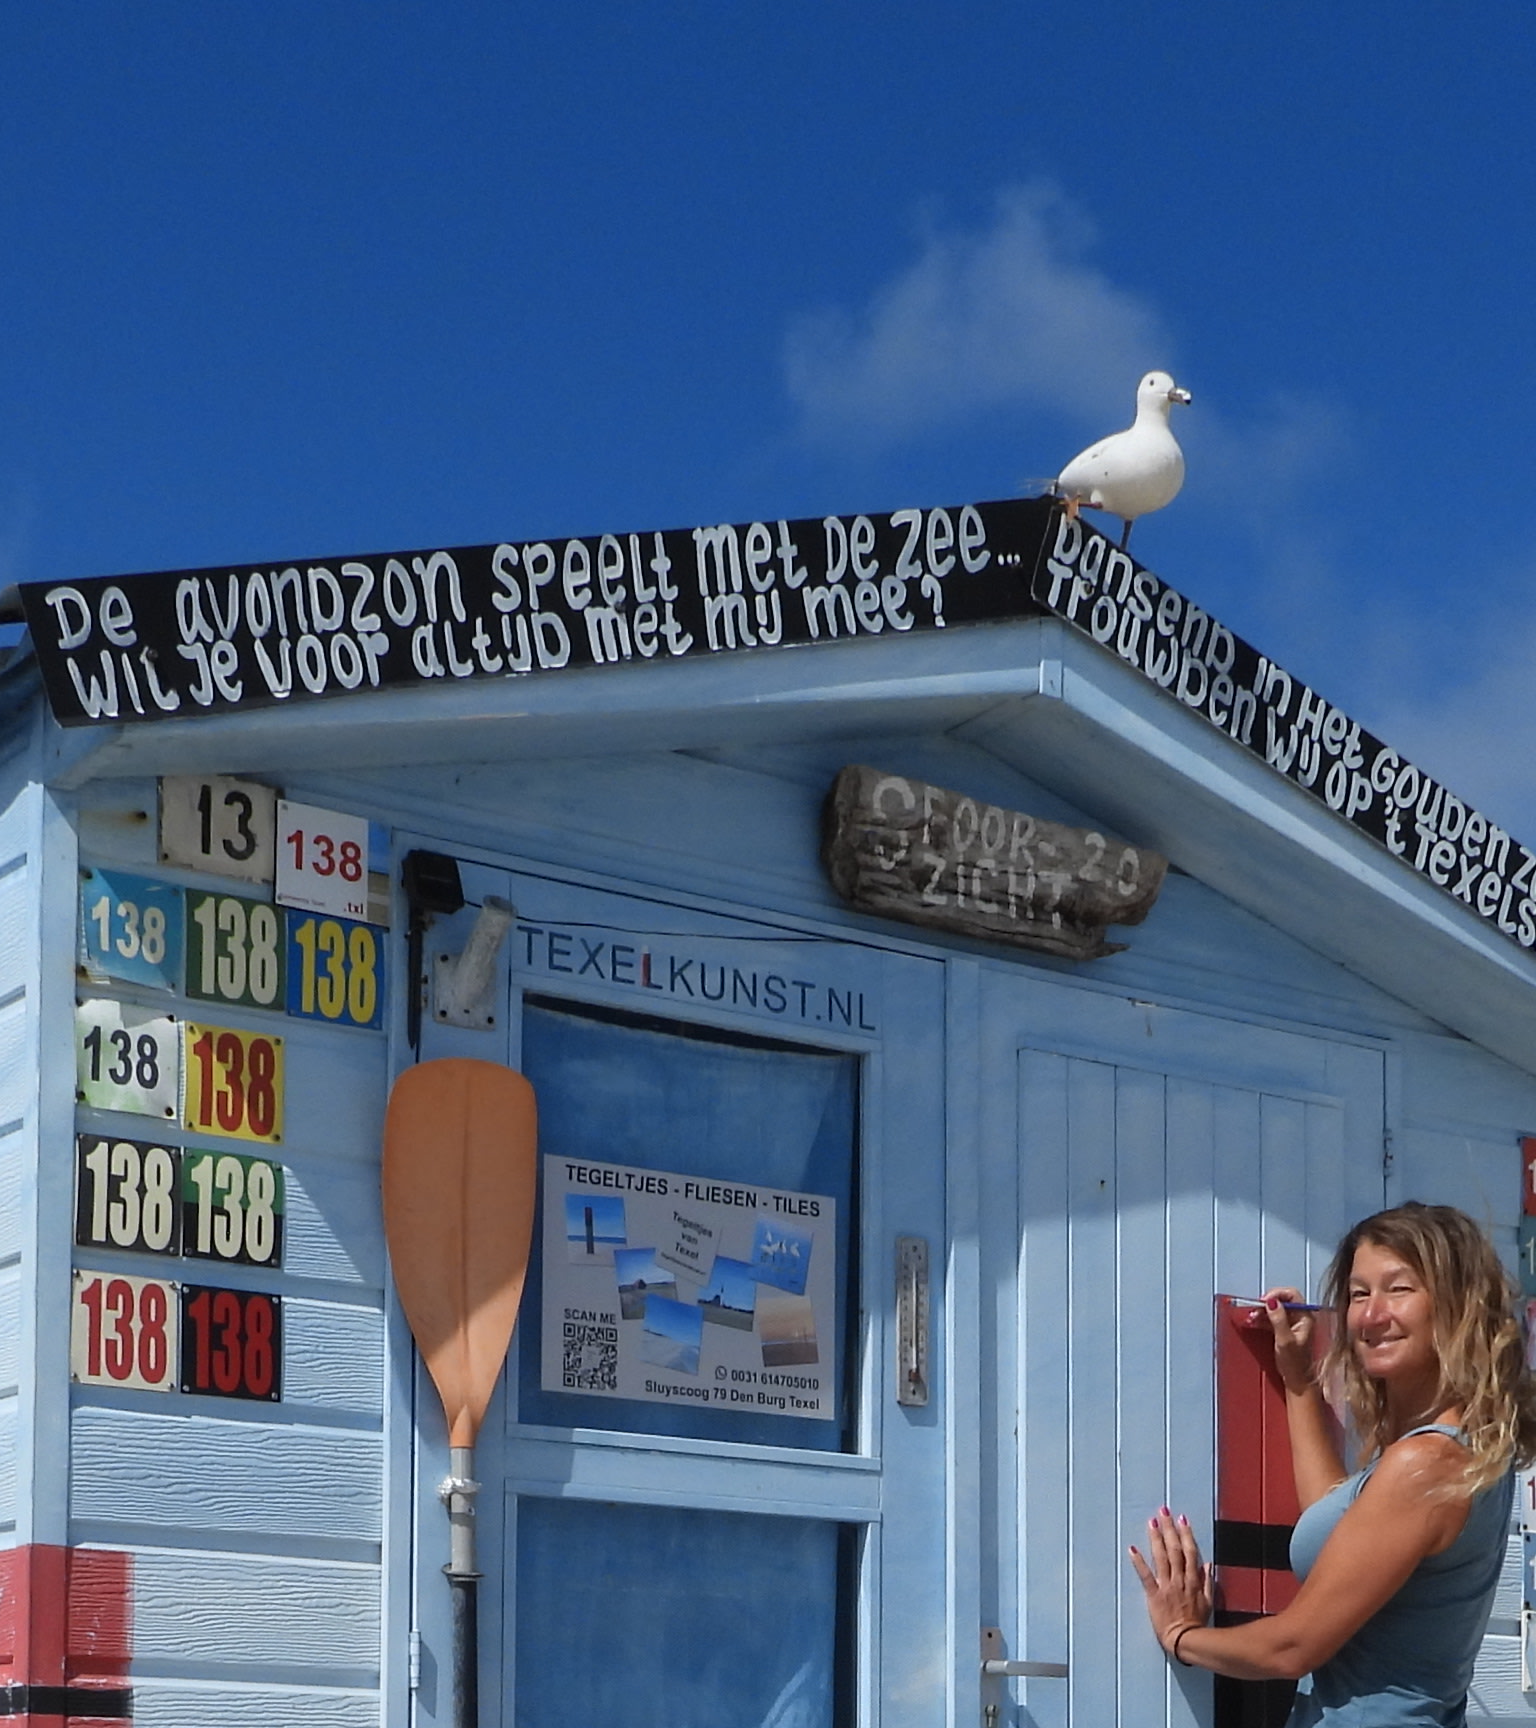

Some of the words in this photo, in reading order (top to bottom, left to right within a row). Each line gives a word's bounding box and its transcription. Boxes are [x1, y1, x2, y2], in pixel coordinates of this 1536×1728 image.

[46, 586, 136, 648] De
[692, 520, 808, 597] met
[67, 646, 180, 718] Wil
[255, 632, 389, 698] voor
[584, 603, 693, 663] met
[198, 784, 256, 861] 13
[287, 829, 362, 882] 138
[91, 896, 165, 964] 138
[193, 896, 278, 1005] 138
[295, 918, 376, 1024] 138
[517, 925, 876, 1031] TEXELKUNST.NL
[83, 1025, 159, 1090] 138
[192, 1031, 276, 1137] 138
[86, 1142, 174, 1251] 138
[191, 1155, 275, 1263] 138
[565, 1164, 668, 1196] TEGELTJES
[685, 1182, 757, 1208] FLIESEN
[773, 1195, 820, 1217] TILES
[81, 1278, 167, 1384] 138
[188, 1291, 273, 1397] 138
[564, 1308, 596, 1322] SCAN
[599, 1312, 616, 1325] ME
[645, 1380, 710, 1401] Sluyscoog
[713, 1387, 727, 1399] 79
[730, 1389, 754, 1403] Den
[758, 1392, 786, 1409] Burg
[789, 1396, 820, 1410] Texel
[731, 1370, 757, 1384] 0031
